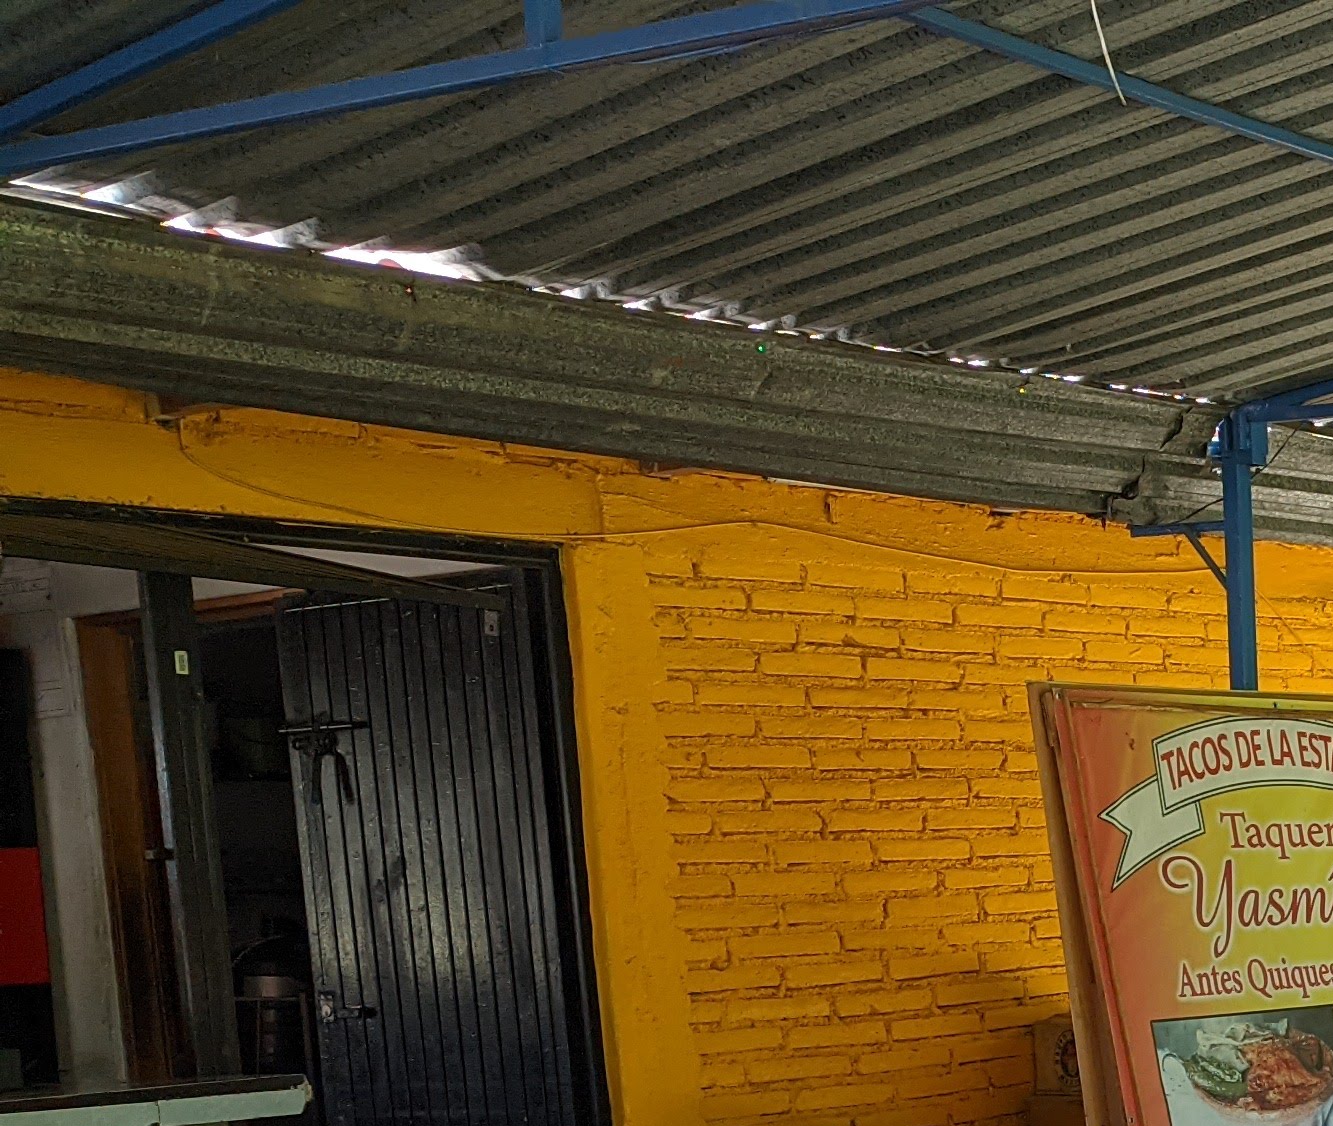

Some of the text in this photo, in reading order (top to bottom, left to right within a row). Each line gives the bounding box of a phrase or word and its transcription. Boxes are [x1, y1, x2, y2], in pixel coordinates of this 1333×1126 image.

[1160, 733, 1233, 791] TACOS
[1234, 729, 1265, 769] DE
[1267, 729, 1296, 767] LA
[1178, 962, 1243, 998] Antes
